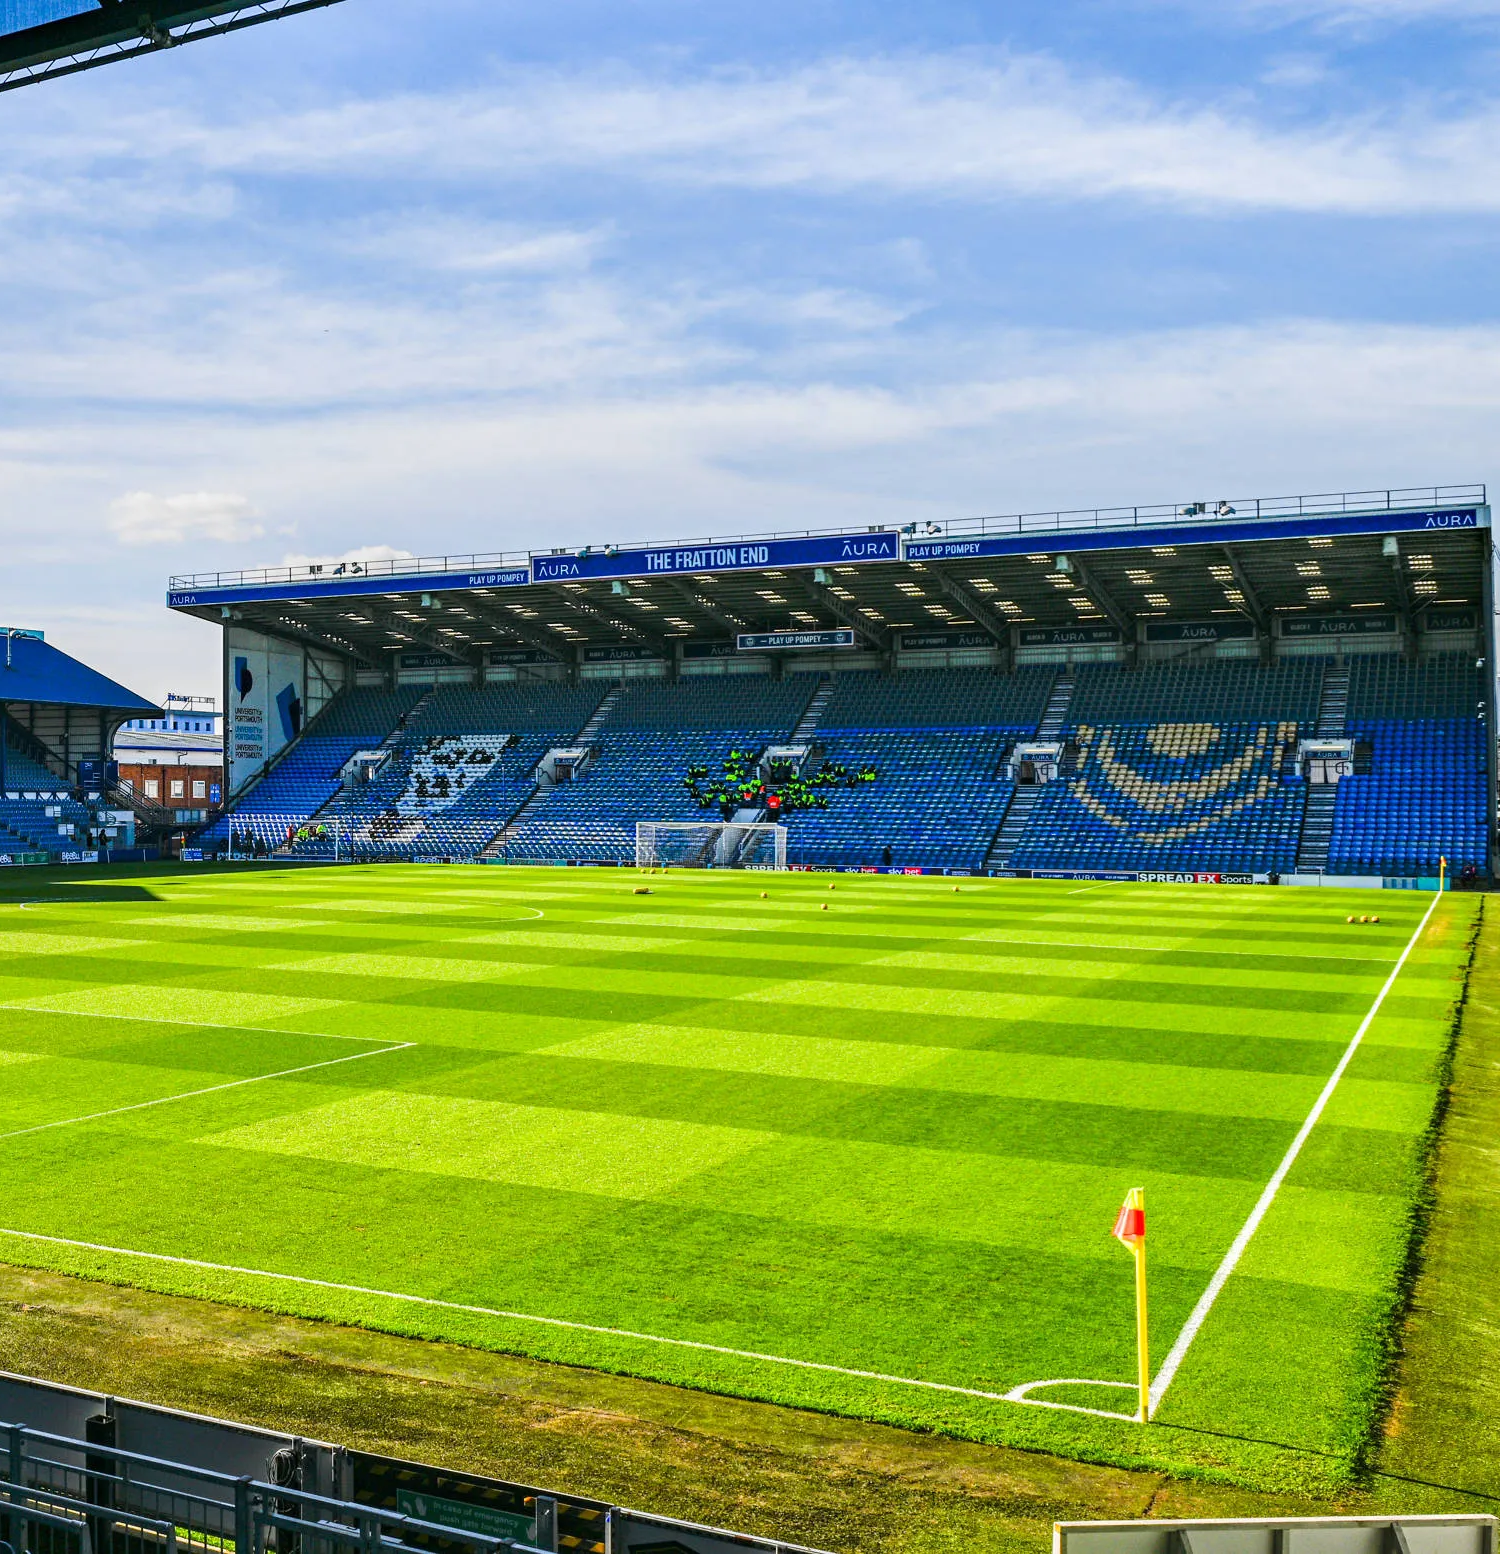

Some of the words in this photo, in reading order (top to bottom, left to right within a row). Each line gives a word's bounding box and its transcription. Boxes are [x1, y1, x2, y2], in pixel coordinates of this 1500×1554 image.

[909, 546, 929, 557] PLAY
[932, 545, 943, 556] UP
[946, 543, 980, 555] POMPEY
[645, 552, 672, 570] THE
[675, 549, 736, 569] FRATTON
[740, 546, 769, 564] END
[469, 575, 485, 585] PLAY
[487, 574, 496, 583] UP
[497, 573, 525, 583] POMPEY
[768, 637, 784, 645] PLAY
[786, 636, 794, 644] UP
[795, 635, 821, 643] POMPEY
[1140, 873, 1193, 883] SPREAD
[1197, 874, 1216, 884] EX
[1220, 875, 1252, 885] Sports
[433, 1501, 441, 1509] In
[443, 1504, 462, 1515] case
[463, 1507, 472, 1516] of
[474, 1510, 518, 1528] emergency
[481, 1522, 513, 1536] forward
